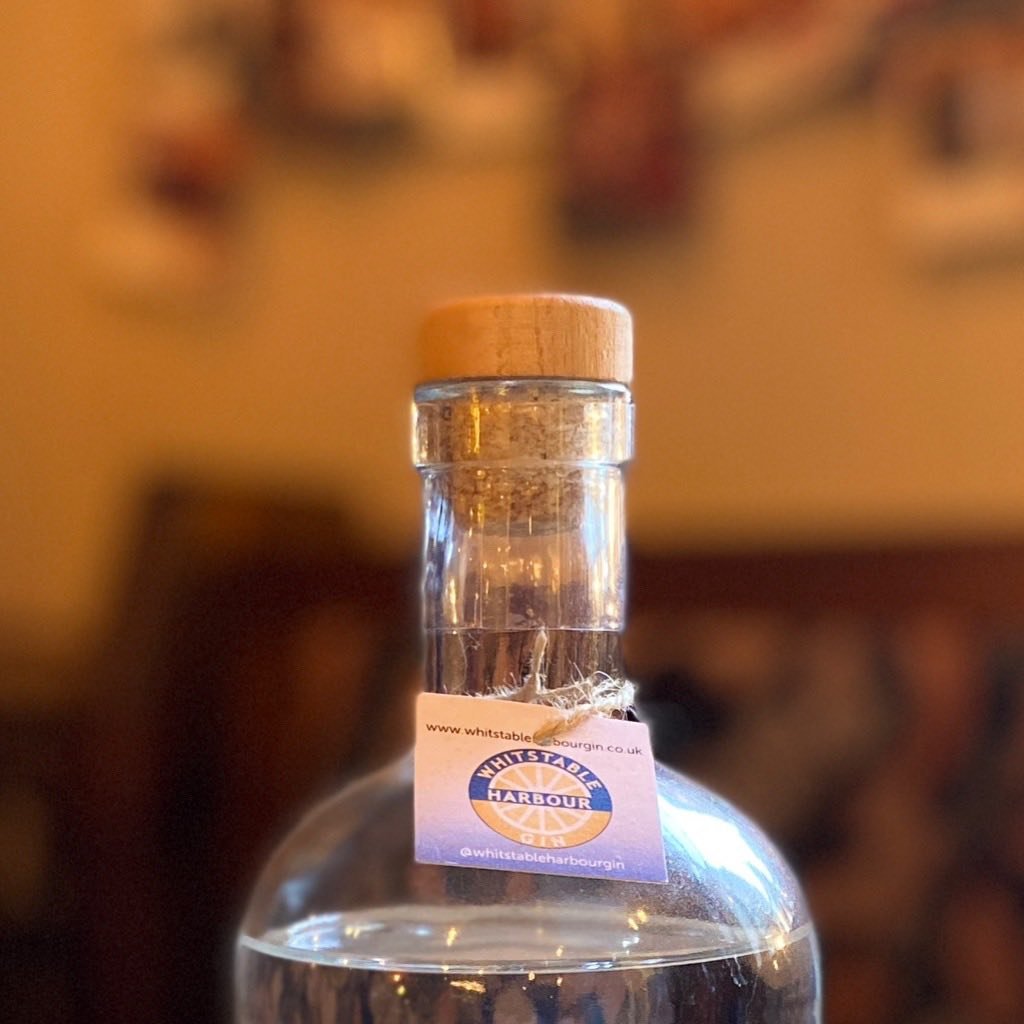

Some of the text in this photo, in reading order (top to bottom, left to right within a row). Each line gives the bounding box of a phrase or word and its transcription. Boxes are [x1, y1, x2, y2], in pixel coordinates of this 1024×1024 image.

[477, 749, 602, 791] WHITSTABLE
[487, 788, 593, 810] HARBOUR
[519, 833, 566, 848] GIN
[459, 847, 625, 870] @whitstableharbourgin
